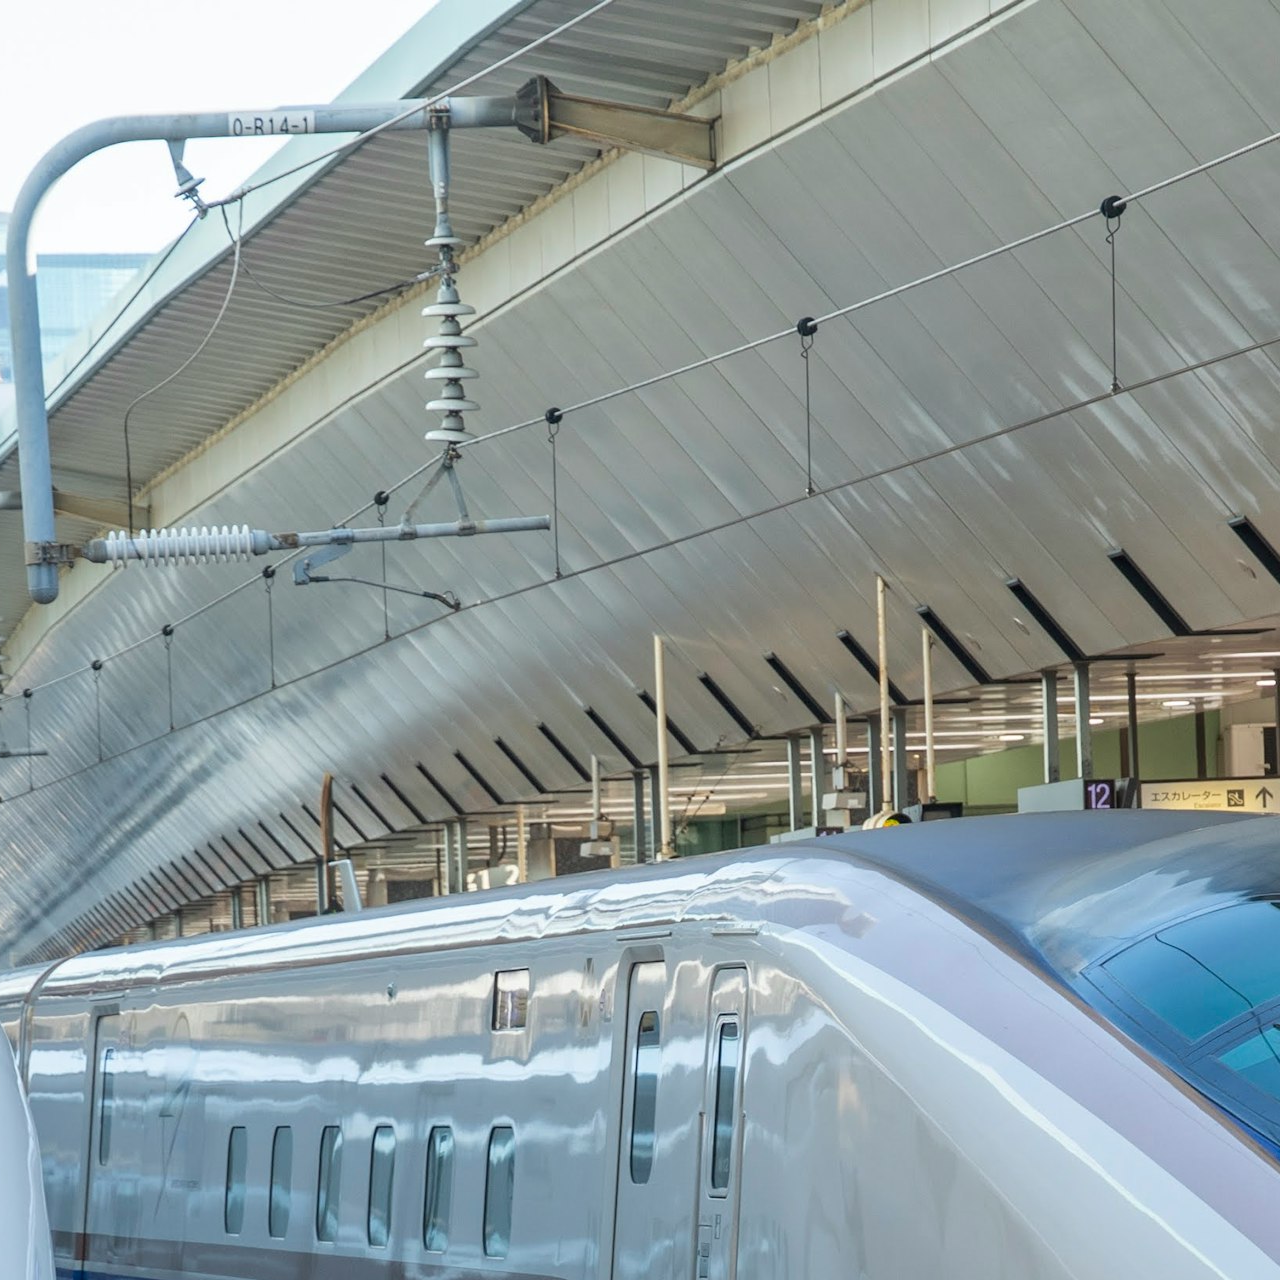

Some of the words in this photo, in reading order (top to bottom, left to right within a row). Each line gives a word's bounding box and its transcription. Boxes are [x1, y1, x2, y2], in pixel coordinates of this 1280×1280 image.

[1087, 783, 1111, 809] 12
[1151, 790, 1222, 802] エスカレーター
